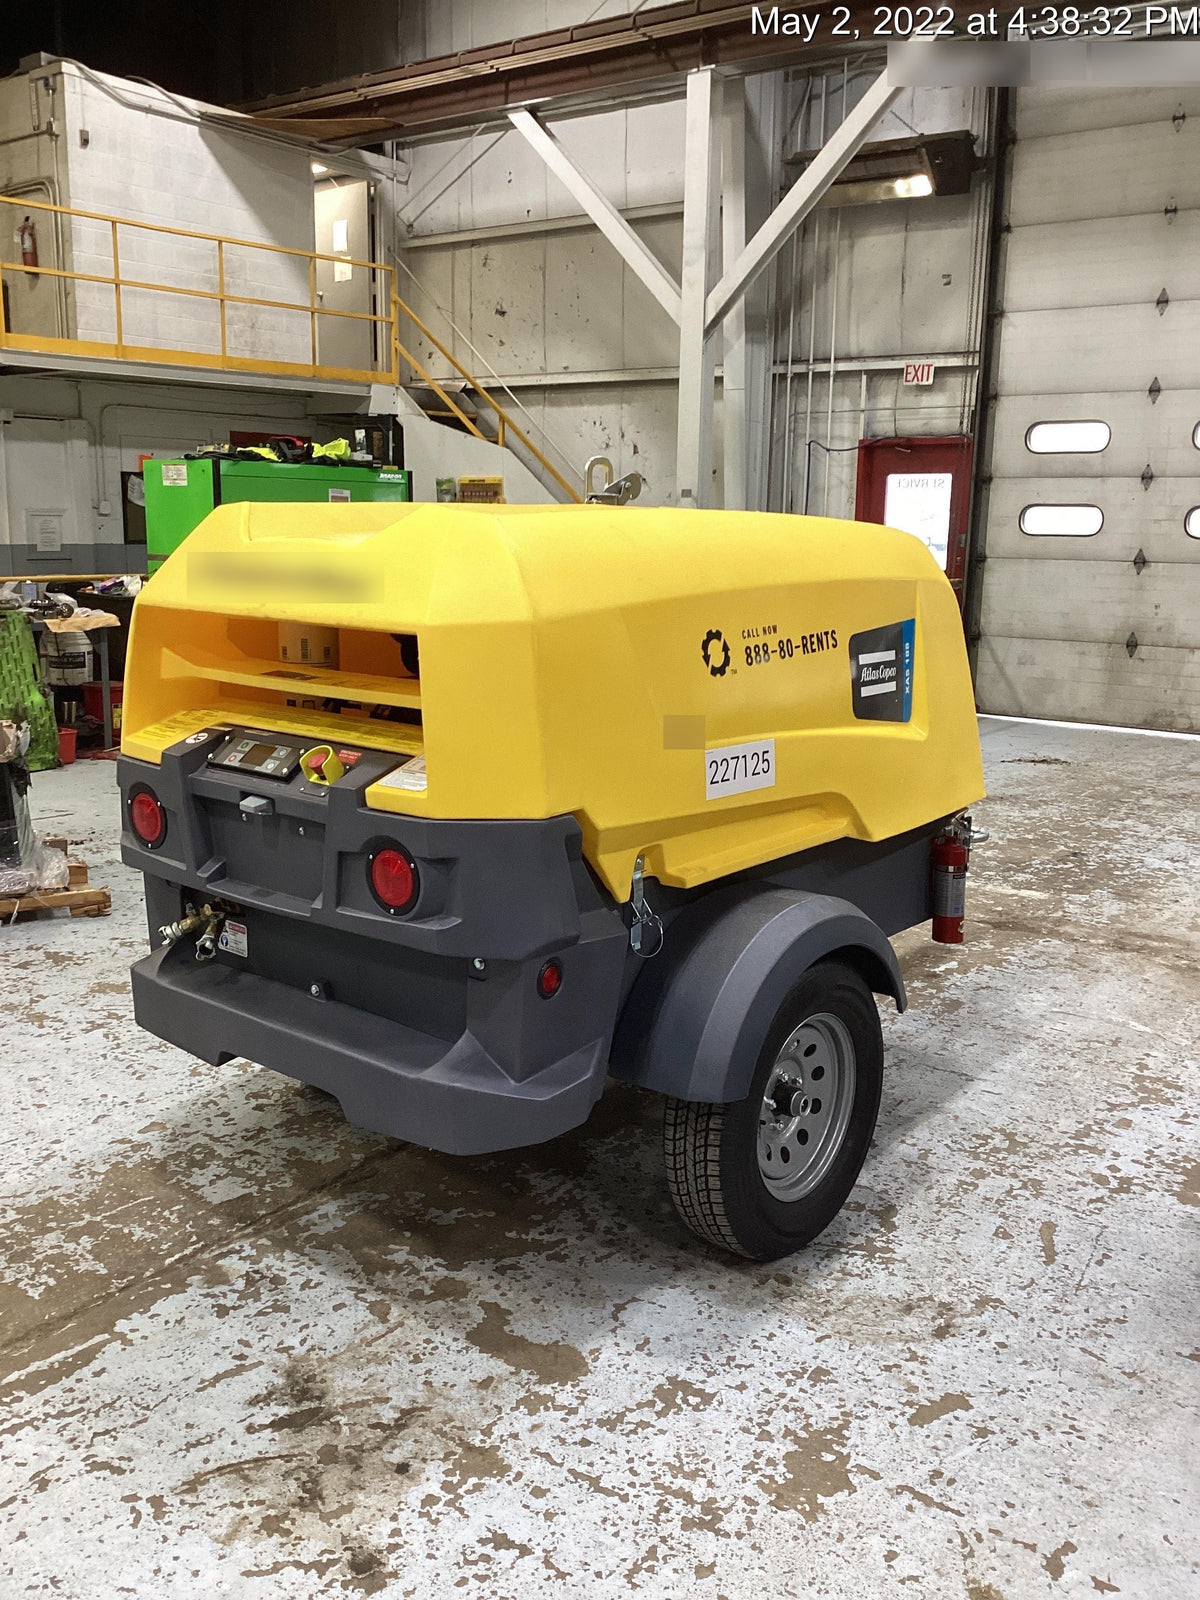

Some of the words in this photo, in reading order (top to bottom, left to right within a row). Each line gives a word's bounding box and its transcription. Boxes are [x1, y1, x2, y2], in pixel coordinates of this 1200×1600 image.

[904, 363, 934, 383] EXIT
[741, 627, 760, 640] CALL
[762, 625, 778, 636] NOW
[744, 629, 839, 666] 888-80-RENTS
[860, 666, 880, 683] Atlas
[879, 665, 897, 681] Copco
[709, 750, 770, 785] 227125
